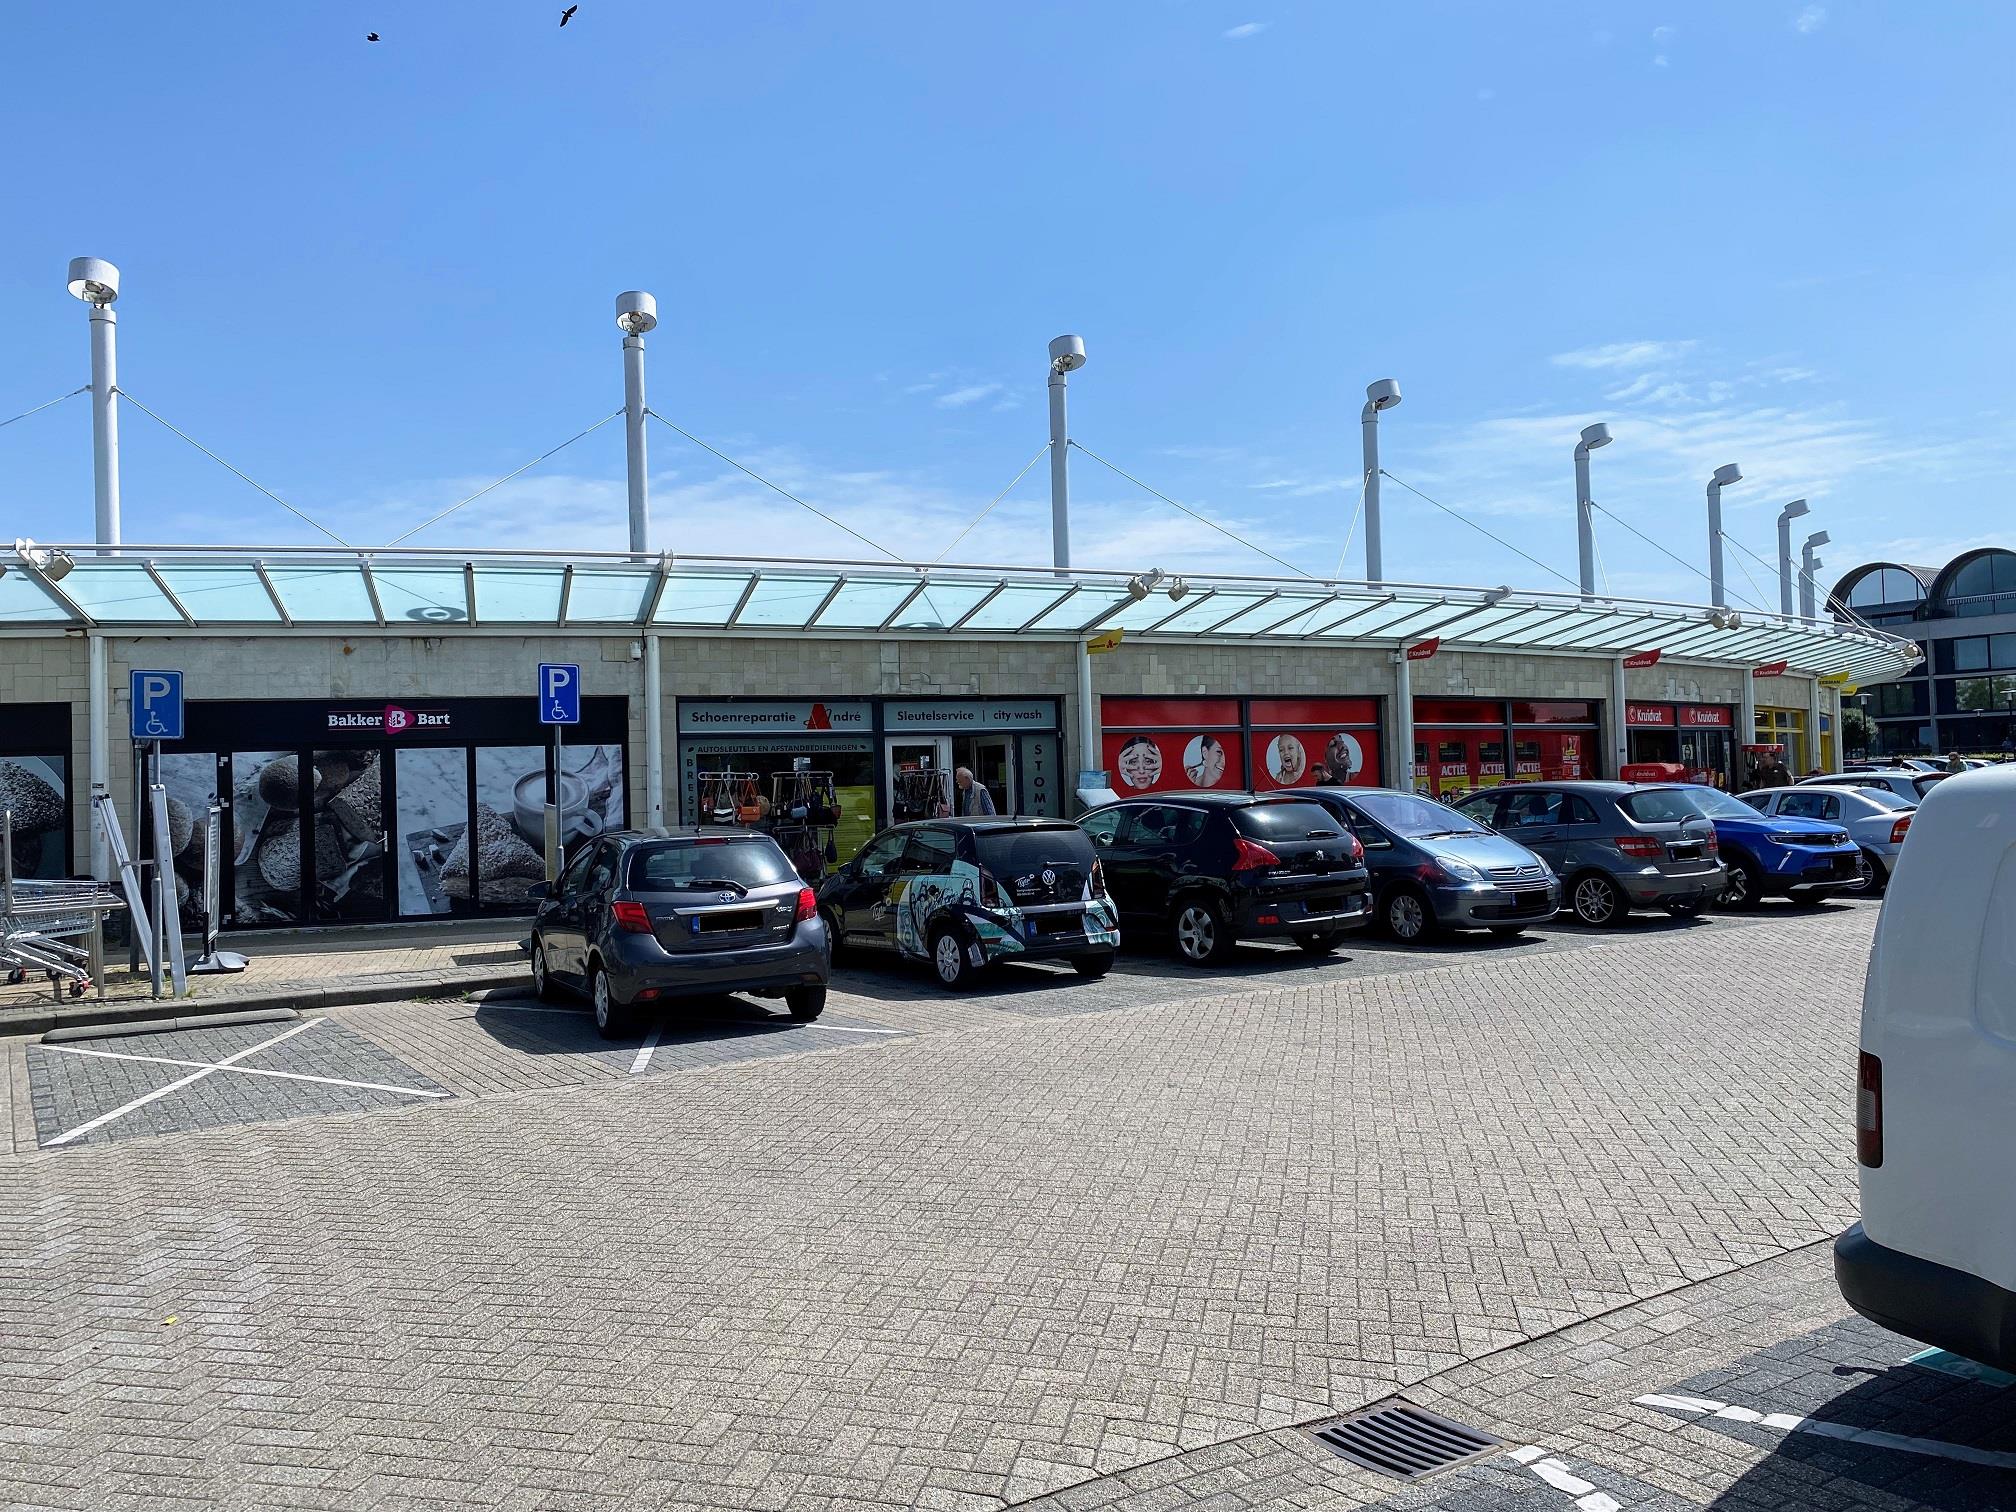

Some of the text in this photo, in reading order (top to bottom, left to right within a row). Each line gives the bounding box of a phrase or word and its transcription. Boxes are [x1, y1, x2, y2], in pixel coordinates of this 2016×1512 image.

[549, 669, 570, 697] P
[144, 676, 170, 709] P
[328, 714, 383, 727] Bakker
[417, 713, 450, 725] Bart
[691, 712, 796, 725] Schoenreparatie
[897, 709, 1042, 722] Sleutelservice city wash
[1637, 709, 1662, 722] Kruidvat
[1697, 711, 1720, 723] Kruidvat
[697, 745, 756, 753] AUTOSLEUTELS
[771, 744, 858, 752] AFSTANDBEDIENINGEN
[1441, 764, 1467, 776] ACTIE!
[1480, 763, 1505, 775] ACTIE!
[1517, 762, 1541, 773] ACTIE!
